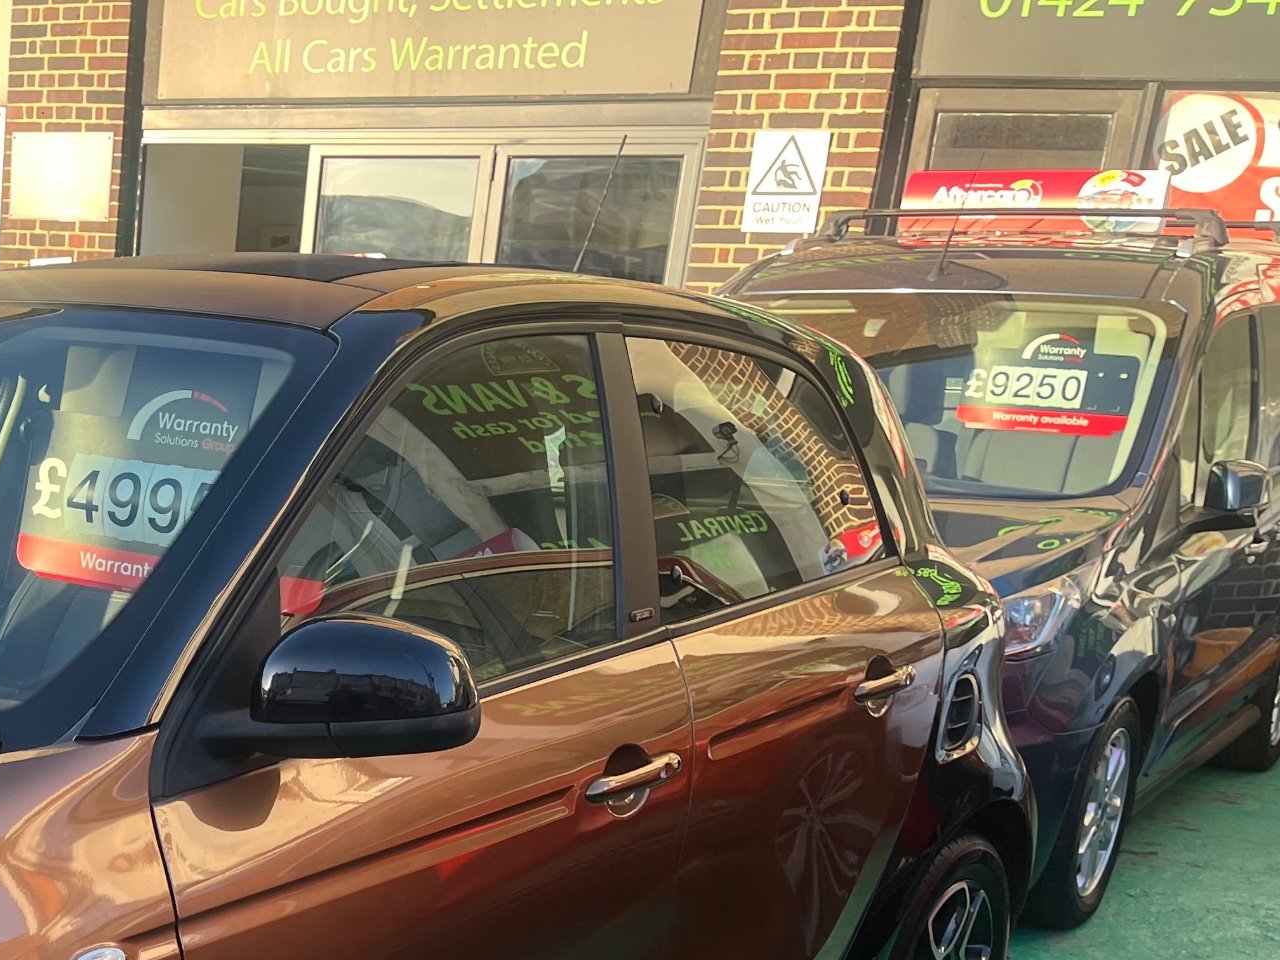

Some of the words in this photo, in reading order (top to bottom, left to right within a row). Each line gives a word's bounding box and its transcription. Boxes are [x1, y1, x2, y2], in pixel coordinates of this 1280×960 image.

[248, 38, 292, 74] All
[302, 39, 377, 74] Cars
[389, 30, 589, 72] Warranted
[1158, 108, 1250, 176] SALE
[752, 202, 811, 213] CAUTION
[1039, 344, 1087, 359] Warranty
[964, 368, 1082, 402] £9250
[159, 411, 240, 443] Warranty
[992, 410, 1040, 425] Warranty
[1040, 415, 1090, 427] available
[154, 432, 199, 449] Solutions
[202, 438, 236, 457] Group
[80, 551, 154, 579] Warrant
